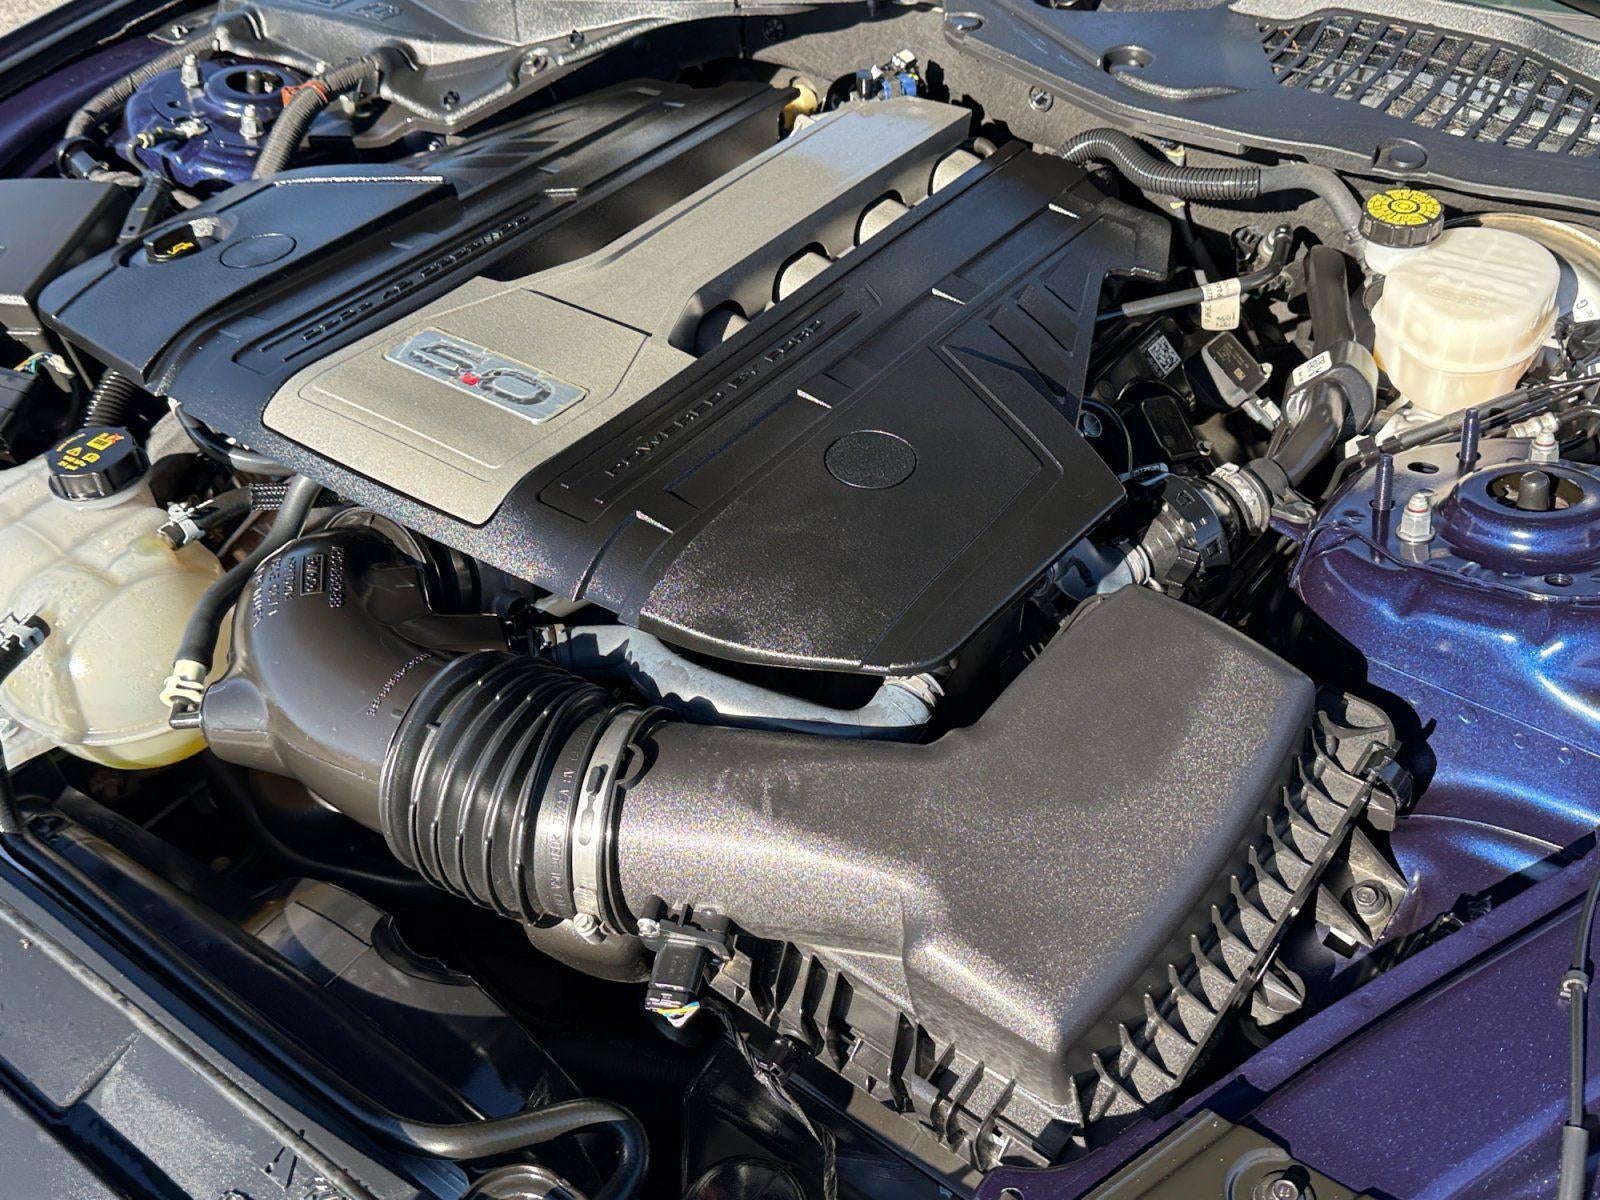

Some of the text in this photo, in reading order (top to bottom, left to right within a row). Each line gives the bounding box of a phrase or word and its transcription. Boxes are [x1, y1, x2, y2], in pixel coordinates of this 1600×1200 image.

[408, 340, 555, 405] 5.0
[604, 391, 726, 477] POWERED
[764, 319, 824, 362] FORD
